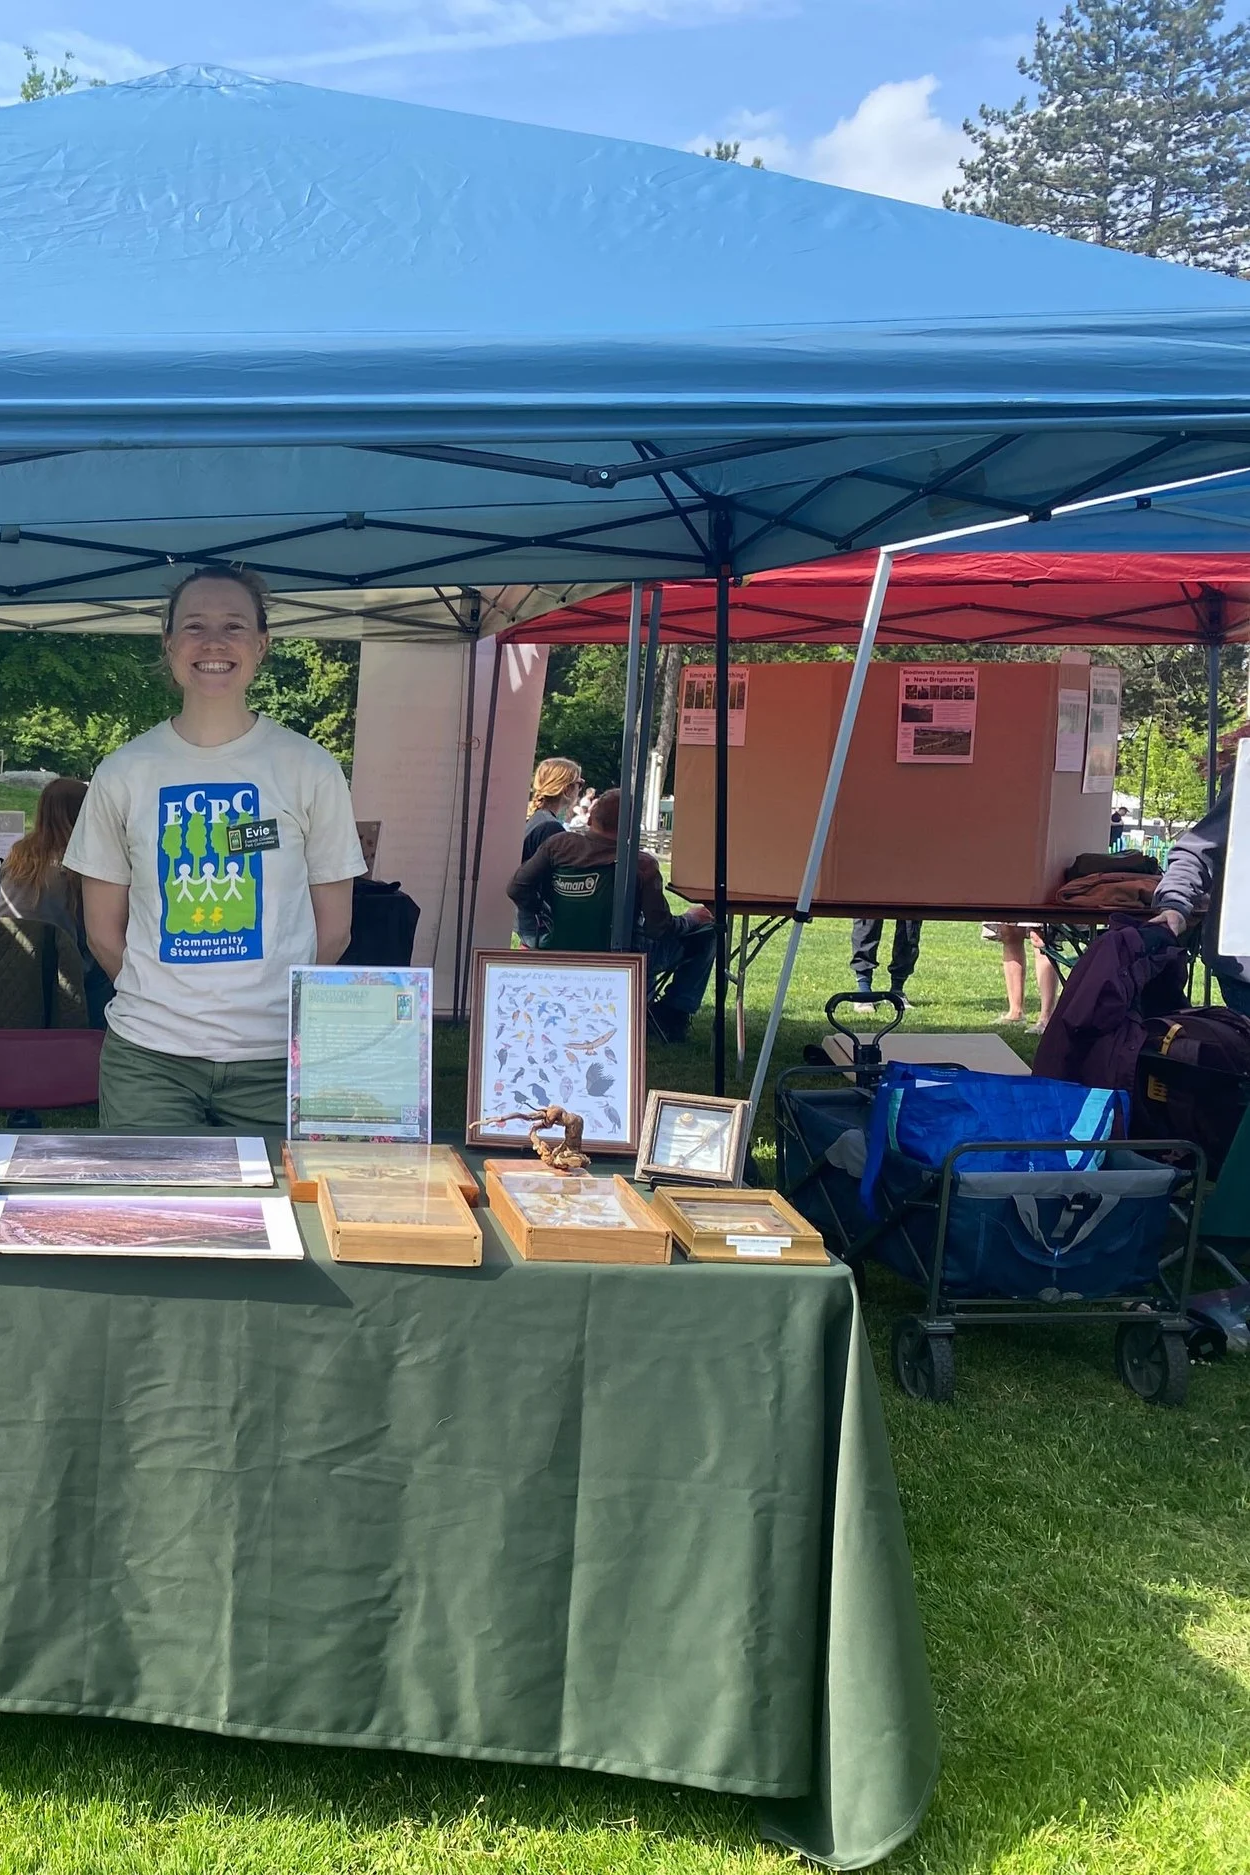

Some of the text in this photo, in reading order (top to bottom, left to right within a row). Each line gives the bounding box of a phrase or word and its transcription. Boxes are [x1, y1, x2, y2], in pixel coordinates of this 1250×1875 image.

[163, 790, 254, 826] ECPC
[245, 826, 270, 838] Evie
[553, 877, 585, 890] oleman
[174, 935, 244, 948] Community
[170, 944, 248, 958] Stewardship
